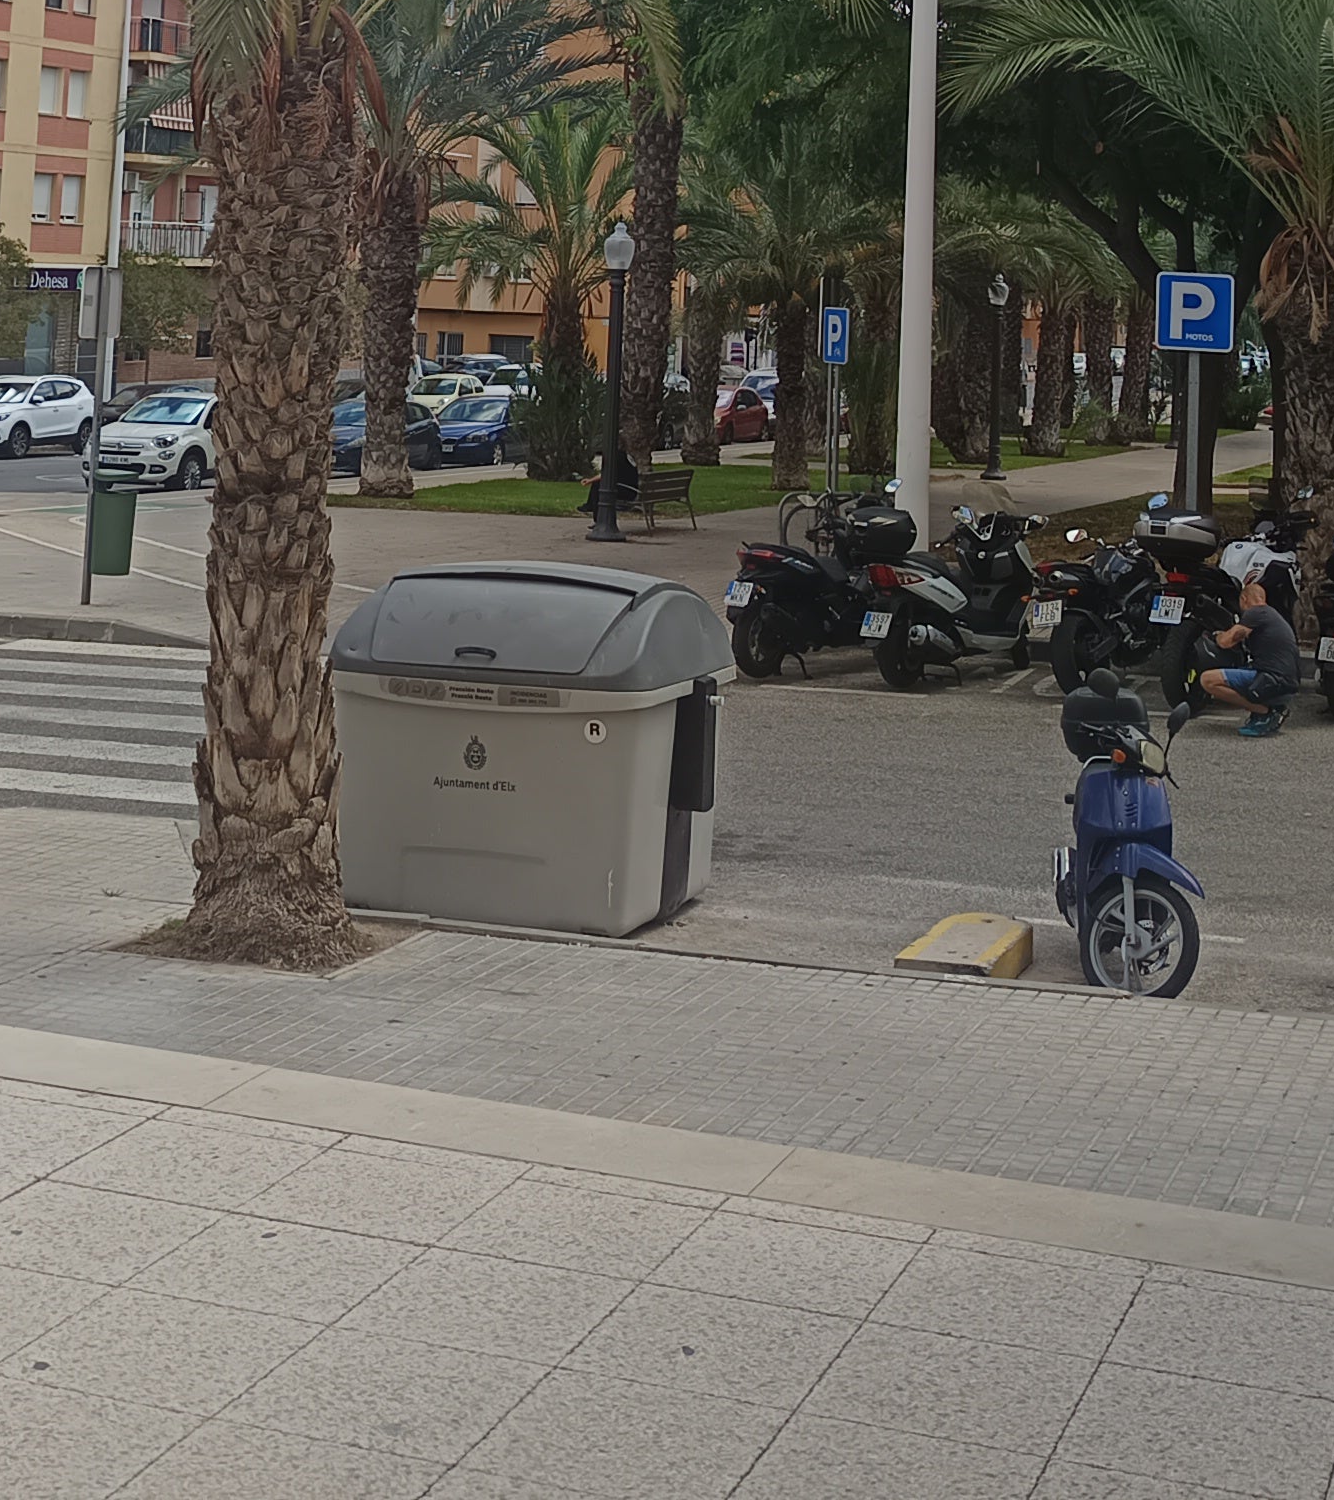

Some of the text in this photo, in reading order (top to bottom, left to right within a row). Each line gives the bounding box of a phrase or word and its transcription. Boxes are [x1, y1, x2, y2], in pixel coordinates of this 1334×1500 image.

[30, 271, 69, 289] Dehesa
[1169, 281, 1215, 339] P
[827, 314, 842, 357] P
[1185, 333, 1214, 342] MOTOS
[1161, 599, 1183, 609] 0319
[1159, 608, 1175, 618] LMT
[589, 722, 600, 736] R
[433, 776, 517, 792] Ajuntament d'Elx
